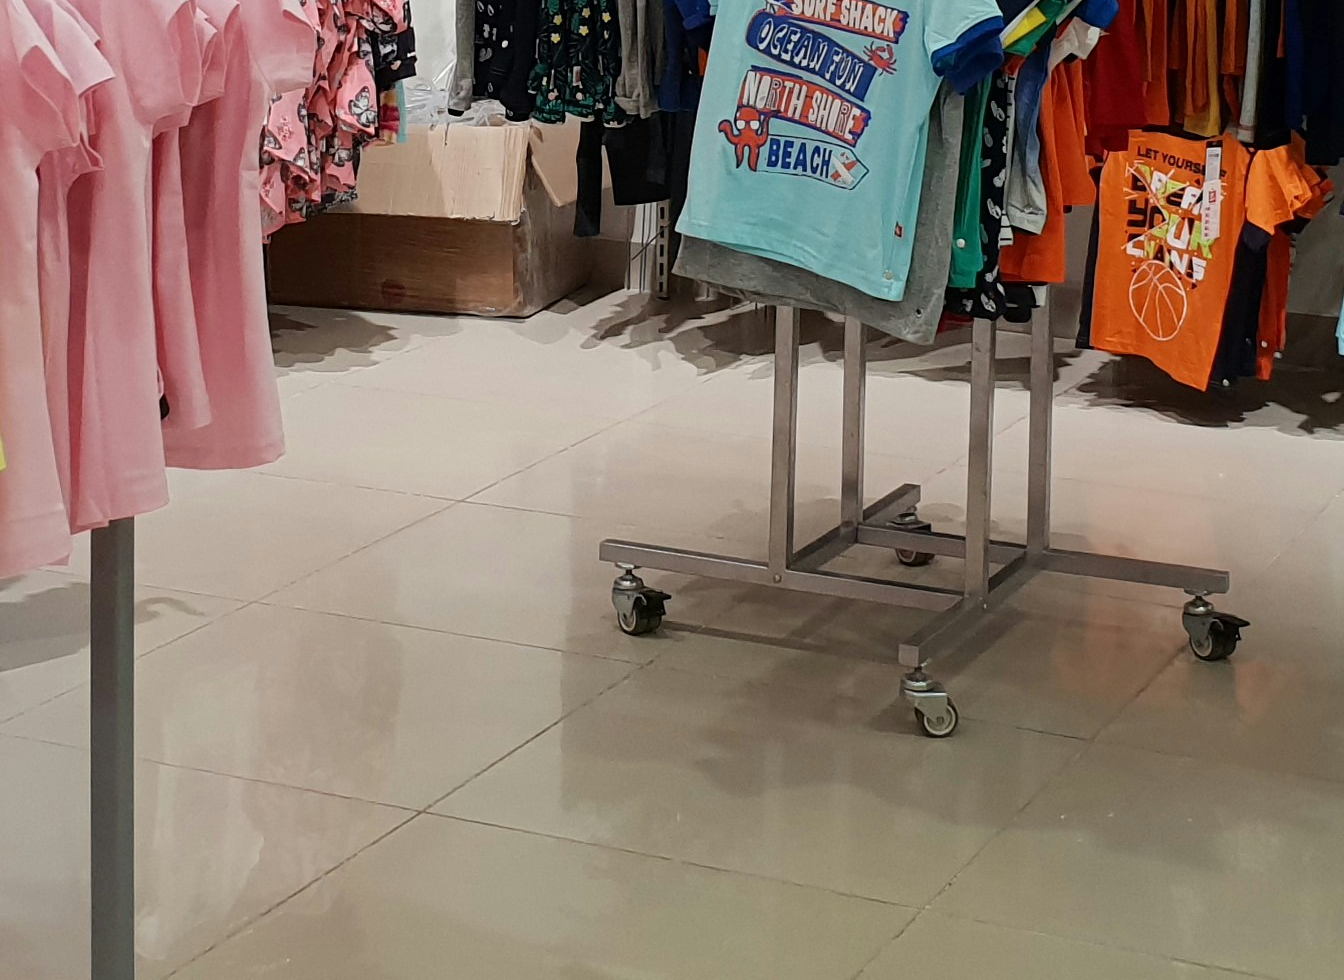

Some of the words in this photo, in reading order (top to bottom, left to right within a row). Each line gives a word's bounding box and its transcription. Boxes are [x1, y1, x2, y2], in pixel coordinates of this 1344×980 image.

[758, 18, 827, 71] OCEAN
[825, 48, 864, 93] FUN
[742, 71, 808, 120] NORTH
[808, 91, 861, 140] SHORE
[767, 138, 833, 179] BEACH
[1137, 146, 1158, 160] LET
